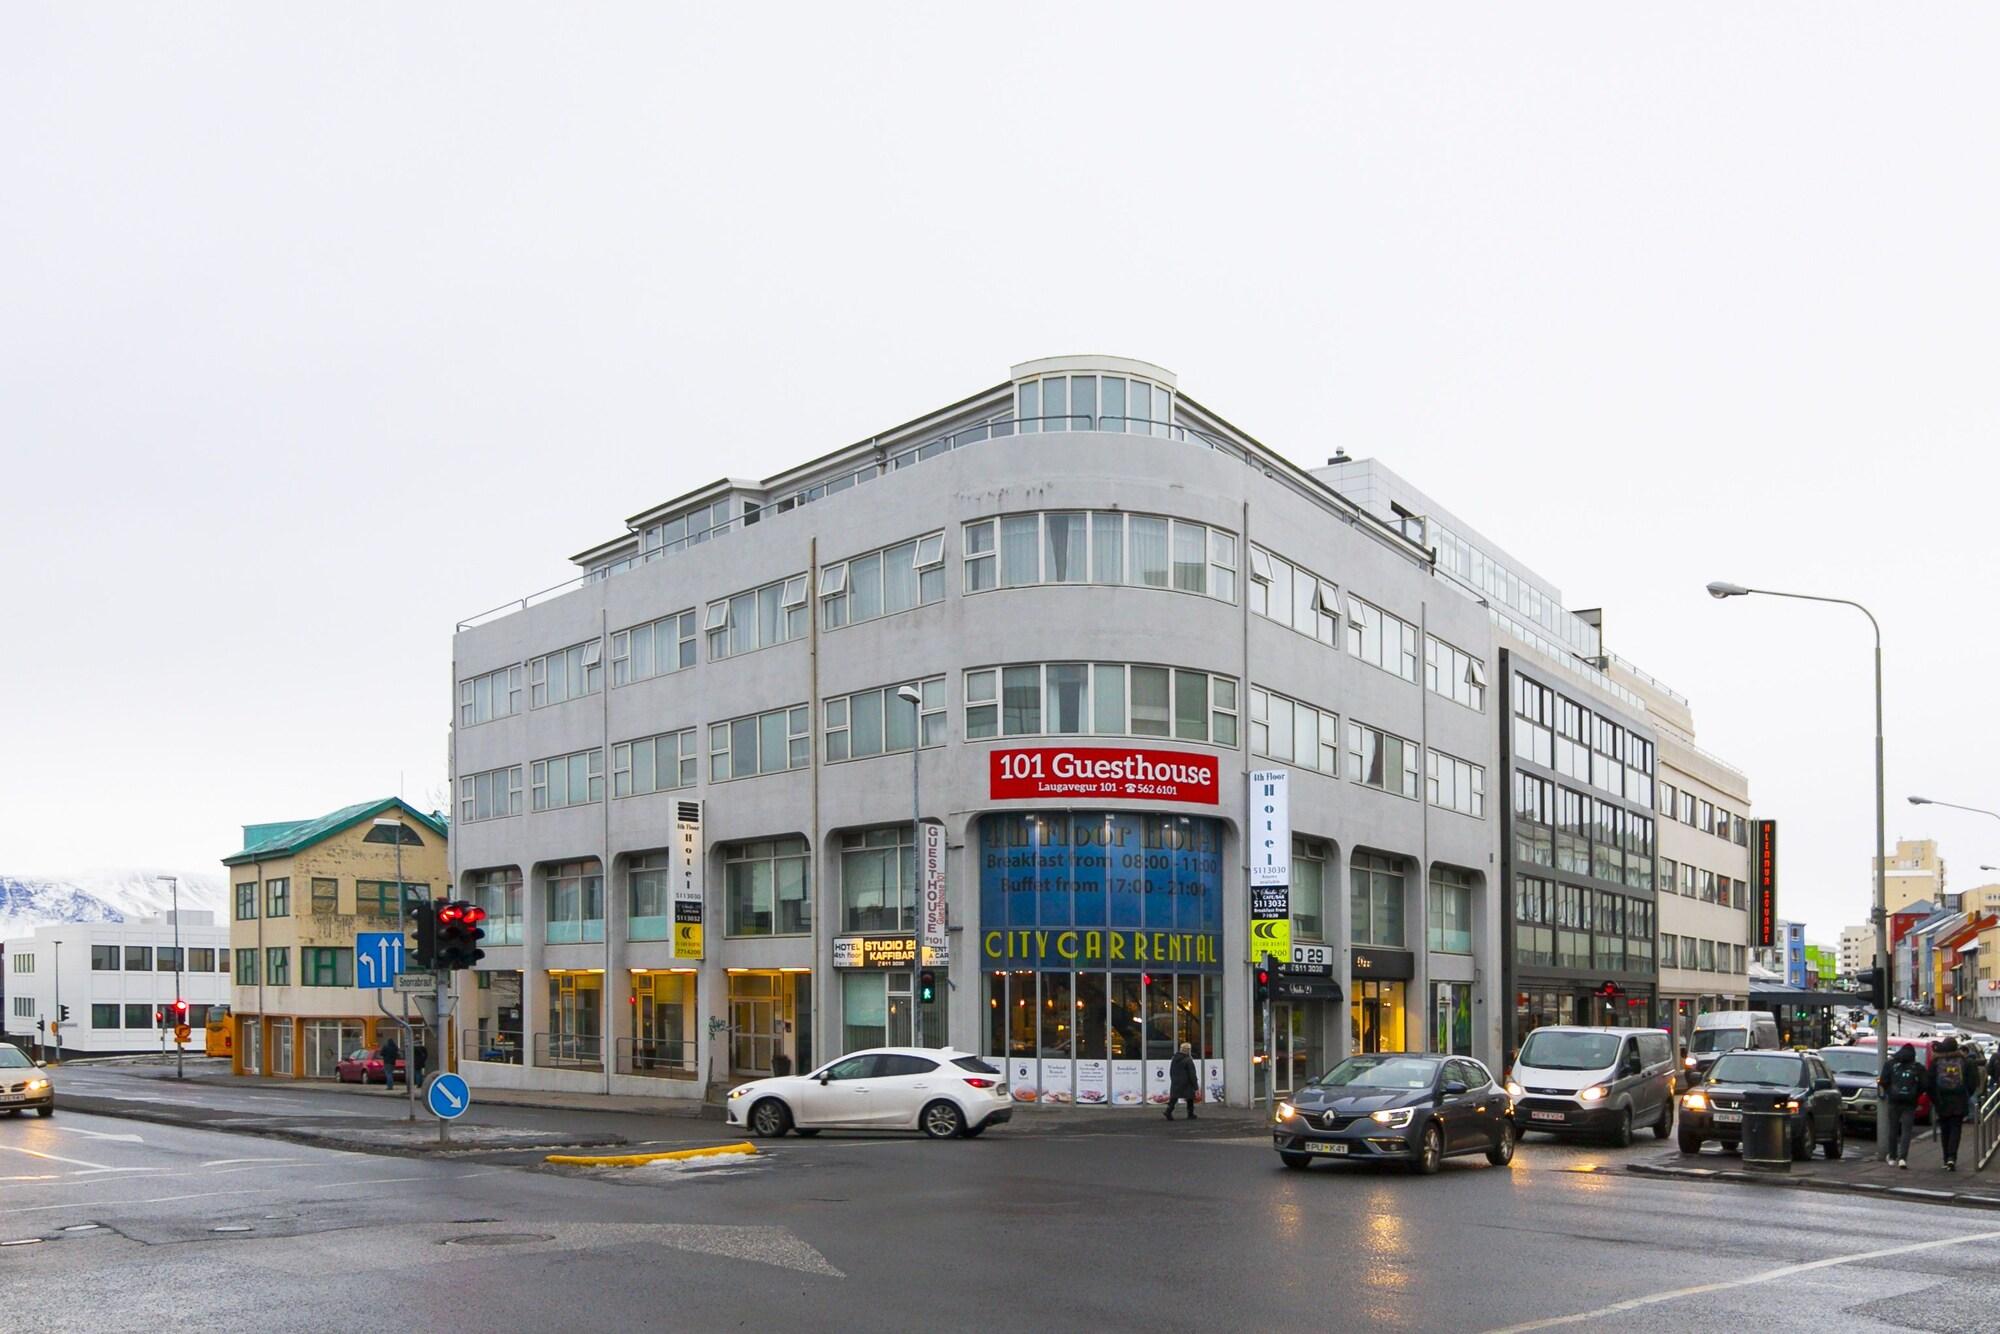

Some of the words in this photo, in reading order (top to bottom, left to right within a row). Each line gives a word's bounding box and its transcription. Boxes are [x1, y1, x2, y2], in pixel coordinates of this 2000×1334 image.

[1000, 753, 1045, 779] 101
[1052, 753, 1211, 785] Guesthouse
[1266, 772, 1285, 780] Floor
[1038, 781, 1097, 793] Laugavegur
[1100, 782, 1117, 792] 101
[1137, 784, 1155, 794] 562
[1156, 784, 1178, 796] 6101
[987, 852, 1064, 868] Breakfast
[1070, 854, 1112, 868] from
[1122, 854, 1168, 870] 08:00
[1183, 858, 1217, 873] 11:00
[927, 826, 938, 933] GUESTHOUSE
[1001, 878, 1050, 892] Buffet
[1056, 878, 1098, 892] from
[1107, 878, 1153, 893] 17:00
[1168, 881, 1206, 896] 21:00
[835, 943, 860, 951] HOTEL
[864, 940, 904, 951] STUDIO
[985, 931, 1048, 958] CITY
[1057, 931, 1126, 959] CAR
[1135, 932, 1217, 963] RENTAL
[870, 951, 914, 960] KAFFIBAR
[1307, 948, 1324, 963] 29
